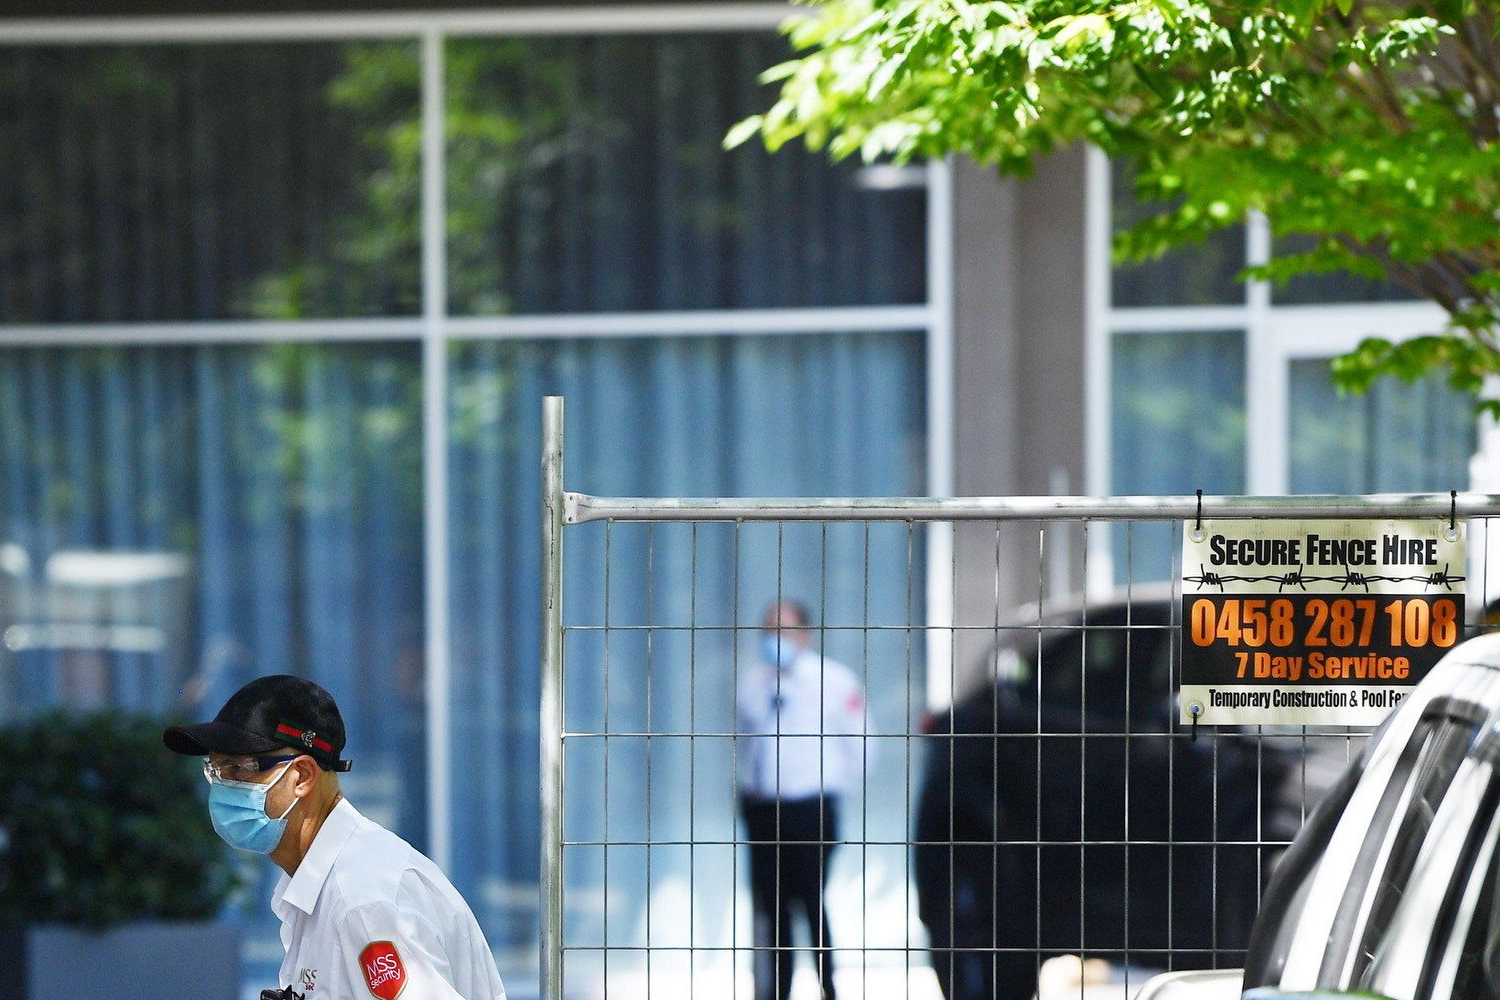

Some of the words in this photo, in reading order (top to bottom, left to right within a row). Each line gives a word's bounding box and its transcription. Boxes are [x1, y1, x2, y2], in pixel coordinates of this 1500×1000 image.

[1210, 534, 1300, 566] SECURE
[1307, 534, 1377, 566] FENCE
[1383, 534, 1437, 566] HIRE
[1191, 598, 1294, 647] 0458
[1304, 598, 1376, 647] 287
[1384, 598, 1457, 647] 108
[1235, 652, 1248, 678] 7
[1254, 652, 1303, 681] Day
[1309, 652, 1409, 679] Service
[1209, 688, 1271, 709] Temporary
[1273, 688, 1347, 708] Construction
[1349, 690, 1358, 707] &
[1362, 690, 1387, 708] Pool
[367, 953, 397, 980] MSS
[371, 969, 400, 989] security
